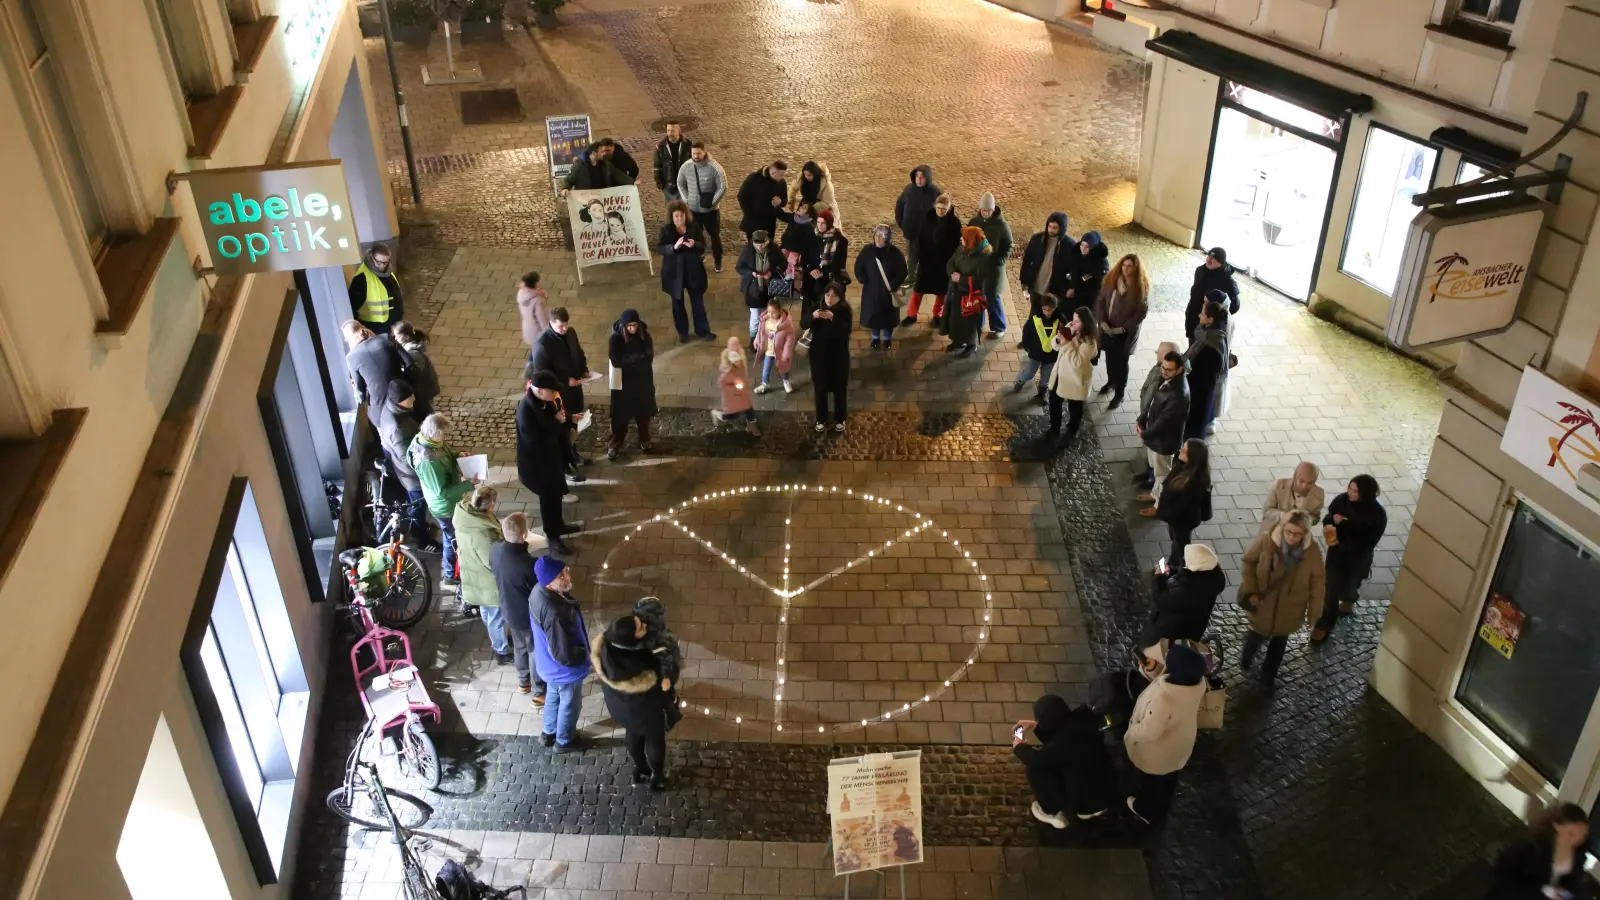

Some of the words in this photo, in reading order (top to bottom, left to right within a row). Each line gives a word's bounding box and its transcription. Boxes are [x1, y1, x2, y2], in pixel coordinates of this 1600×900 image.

[208, 187, 342, 225] abele,
[603, 195, 631, 206] NEVER
[217, 221, 349, 263] optik.
[580, 231, 608, 240] MEANS
[581, 240, 607, 249] NEVER
[611, 238, 634, 246] AGAIN
[582, 250, 596, 259] FOR
[597, 244, 640, 259] ANYONE
[1472, 262, 1513, 277] ANSBACHER
